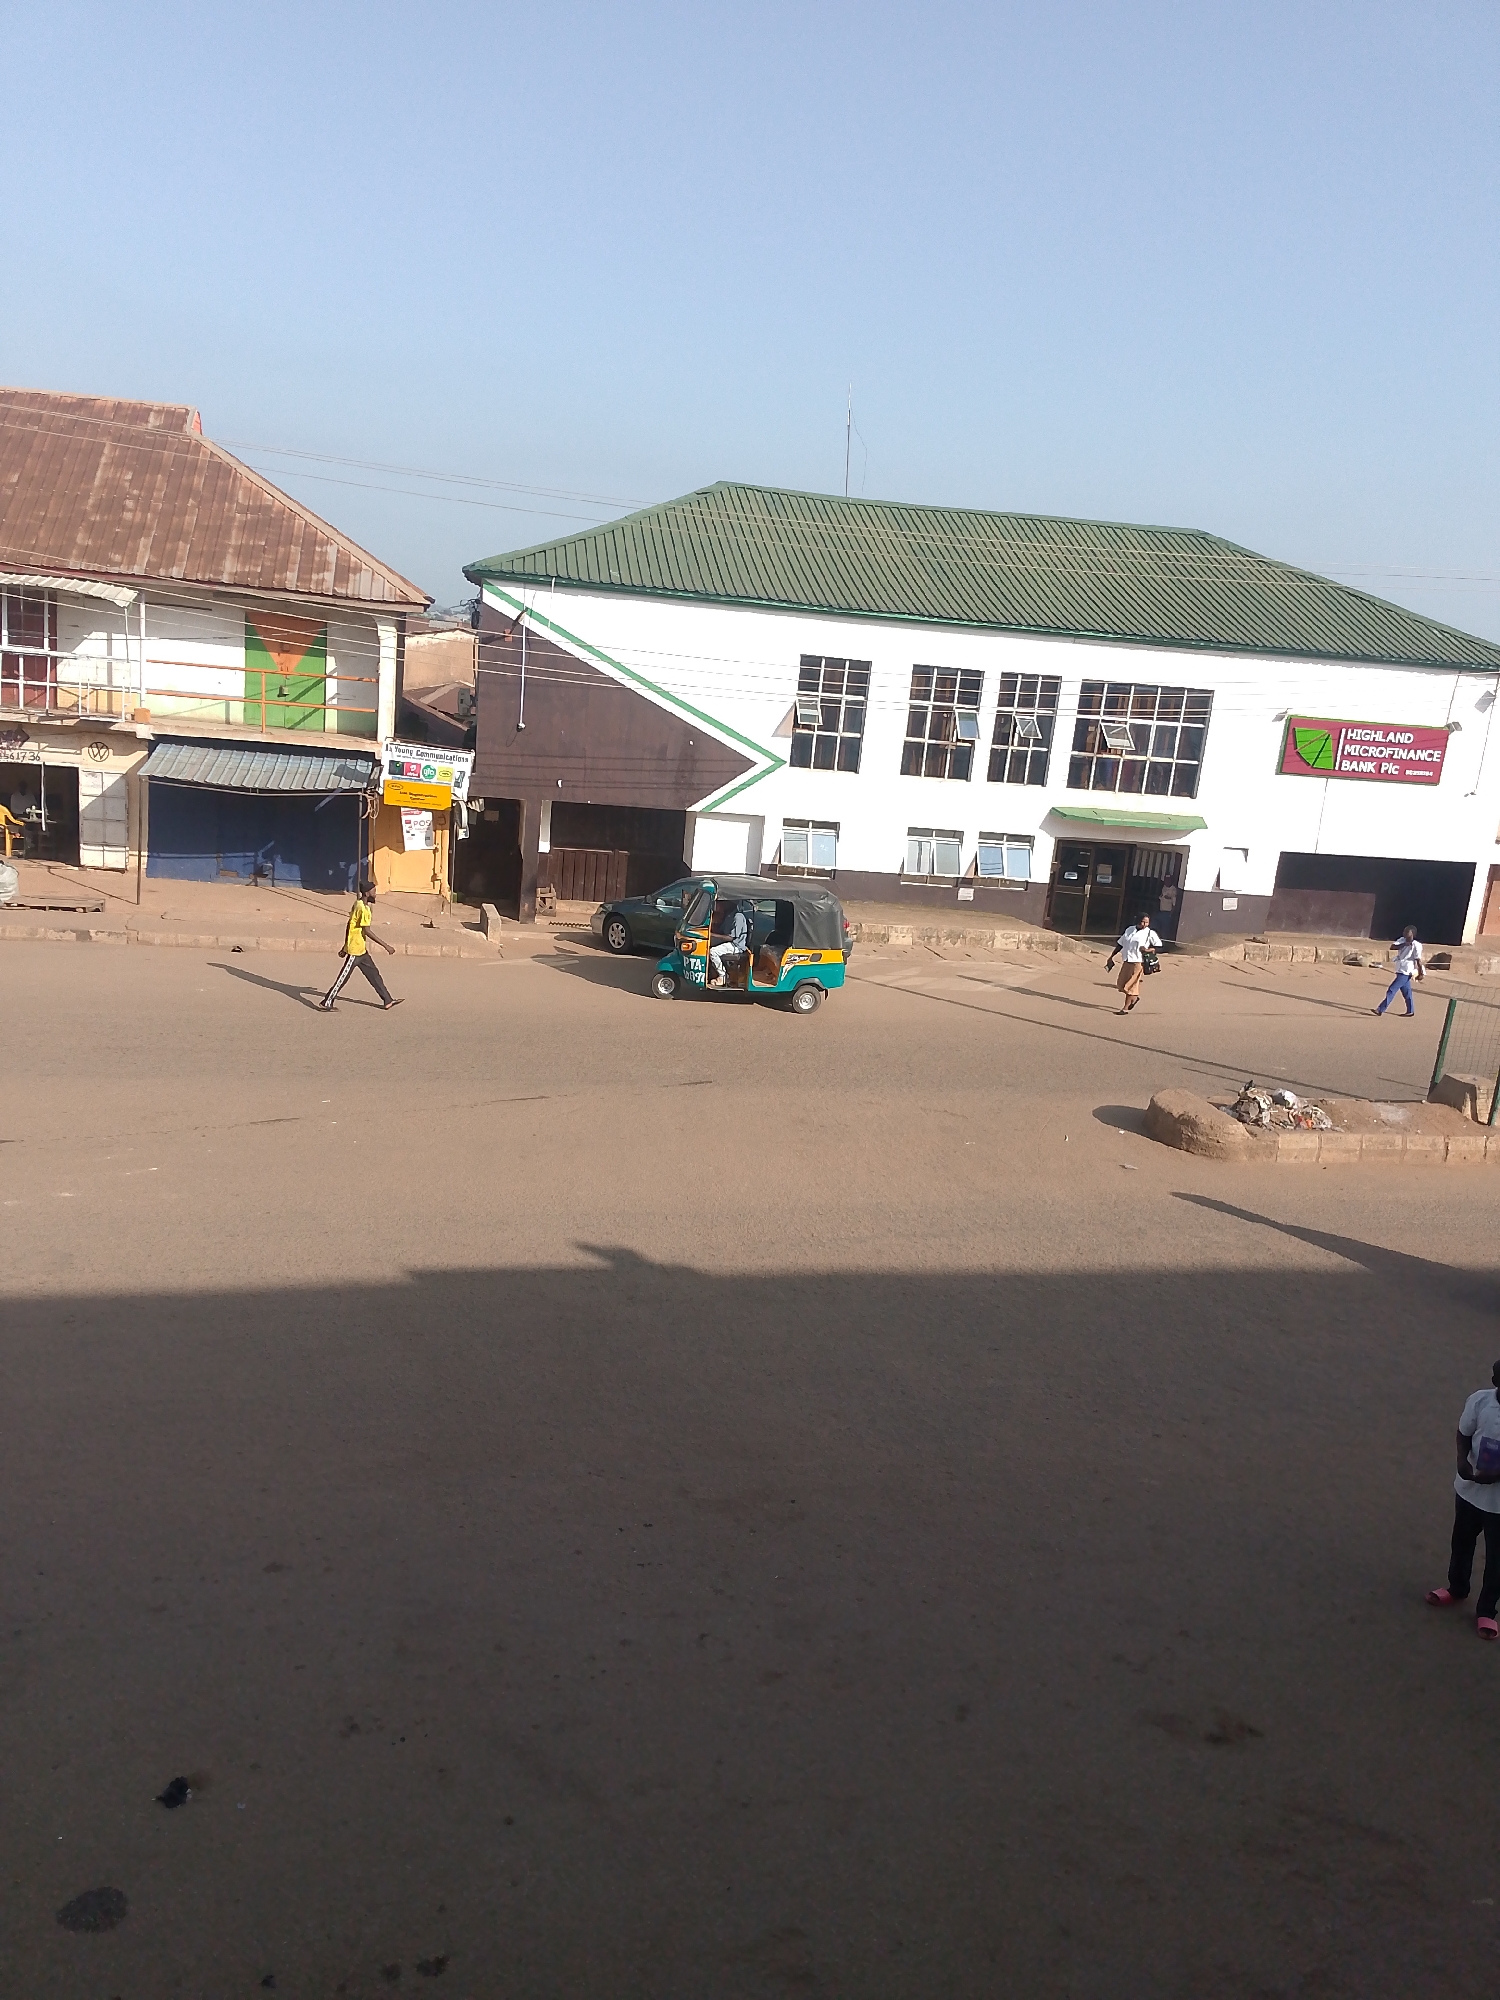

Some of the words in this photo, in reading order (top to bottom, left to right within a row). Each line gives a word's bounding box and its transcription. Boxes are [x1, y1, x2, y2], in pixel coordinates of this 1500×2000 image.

[1347, 729, 1414, 744] HIGHLAND
[394, 745, 414, 757] Young
[415, 749, 469, 763] Communications
[1344, 744, 1442, 762] MICROFINANCE
[1341, 760, 1376, 773] BANK
[413, 819, 432, 827] POS
